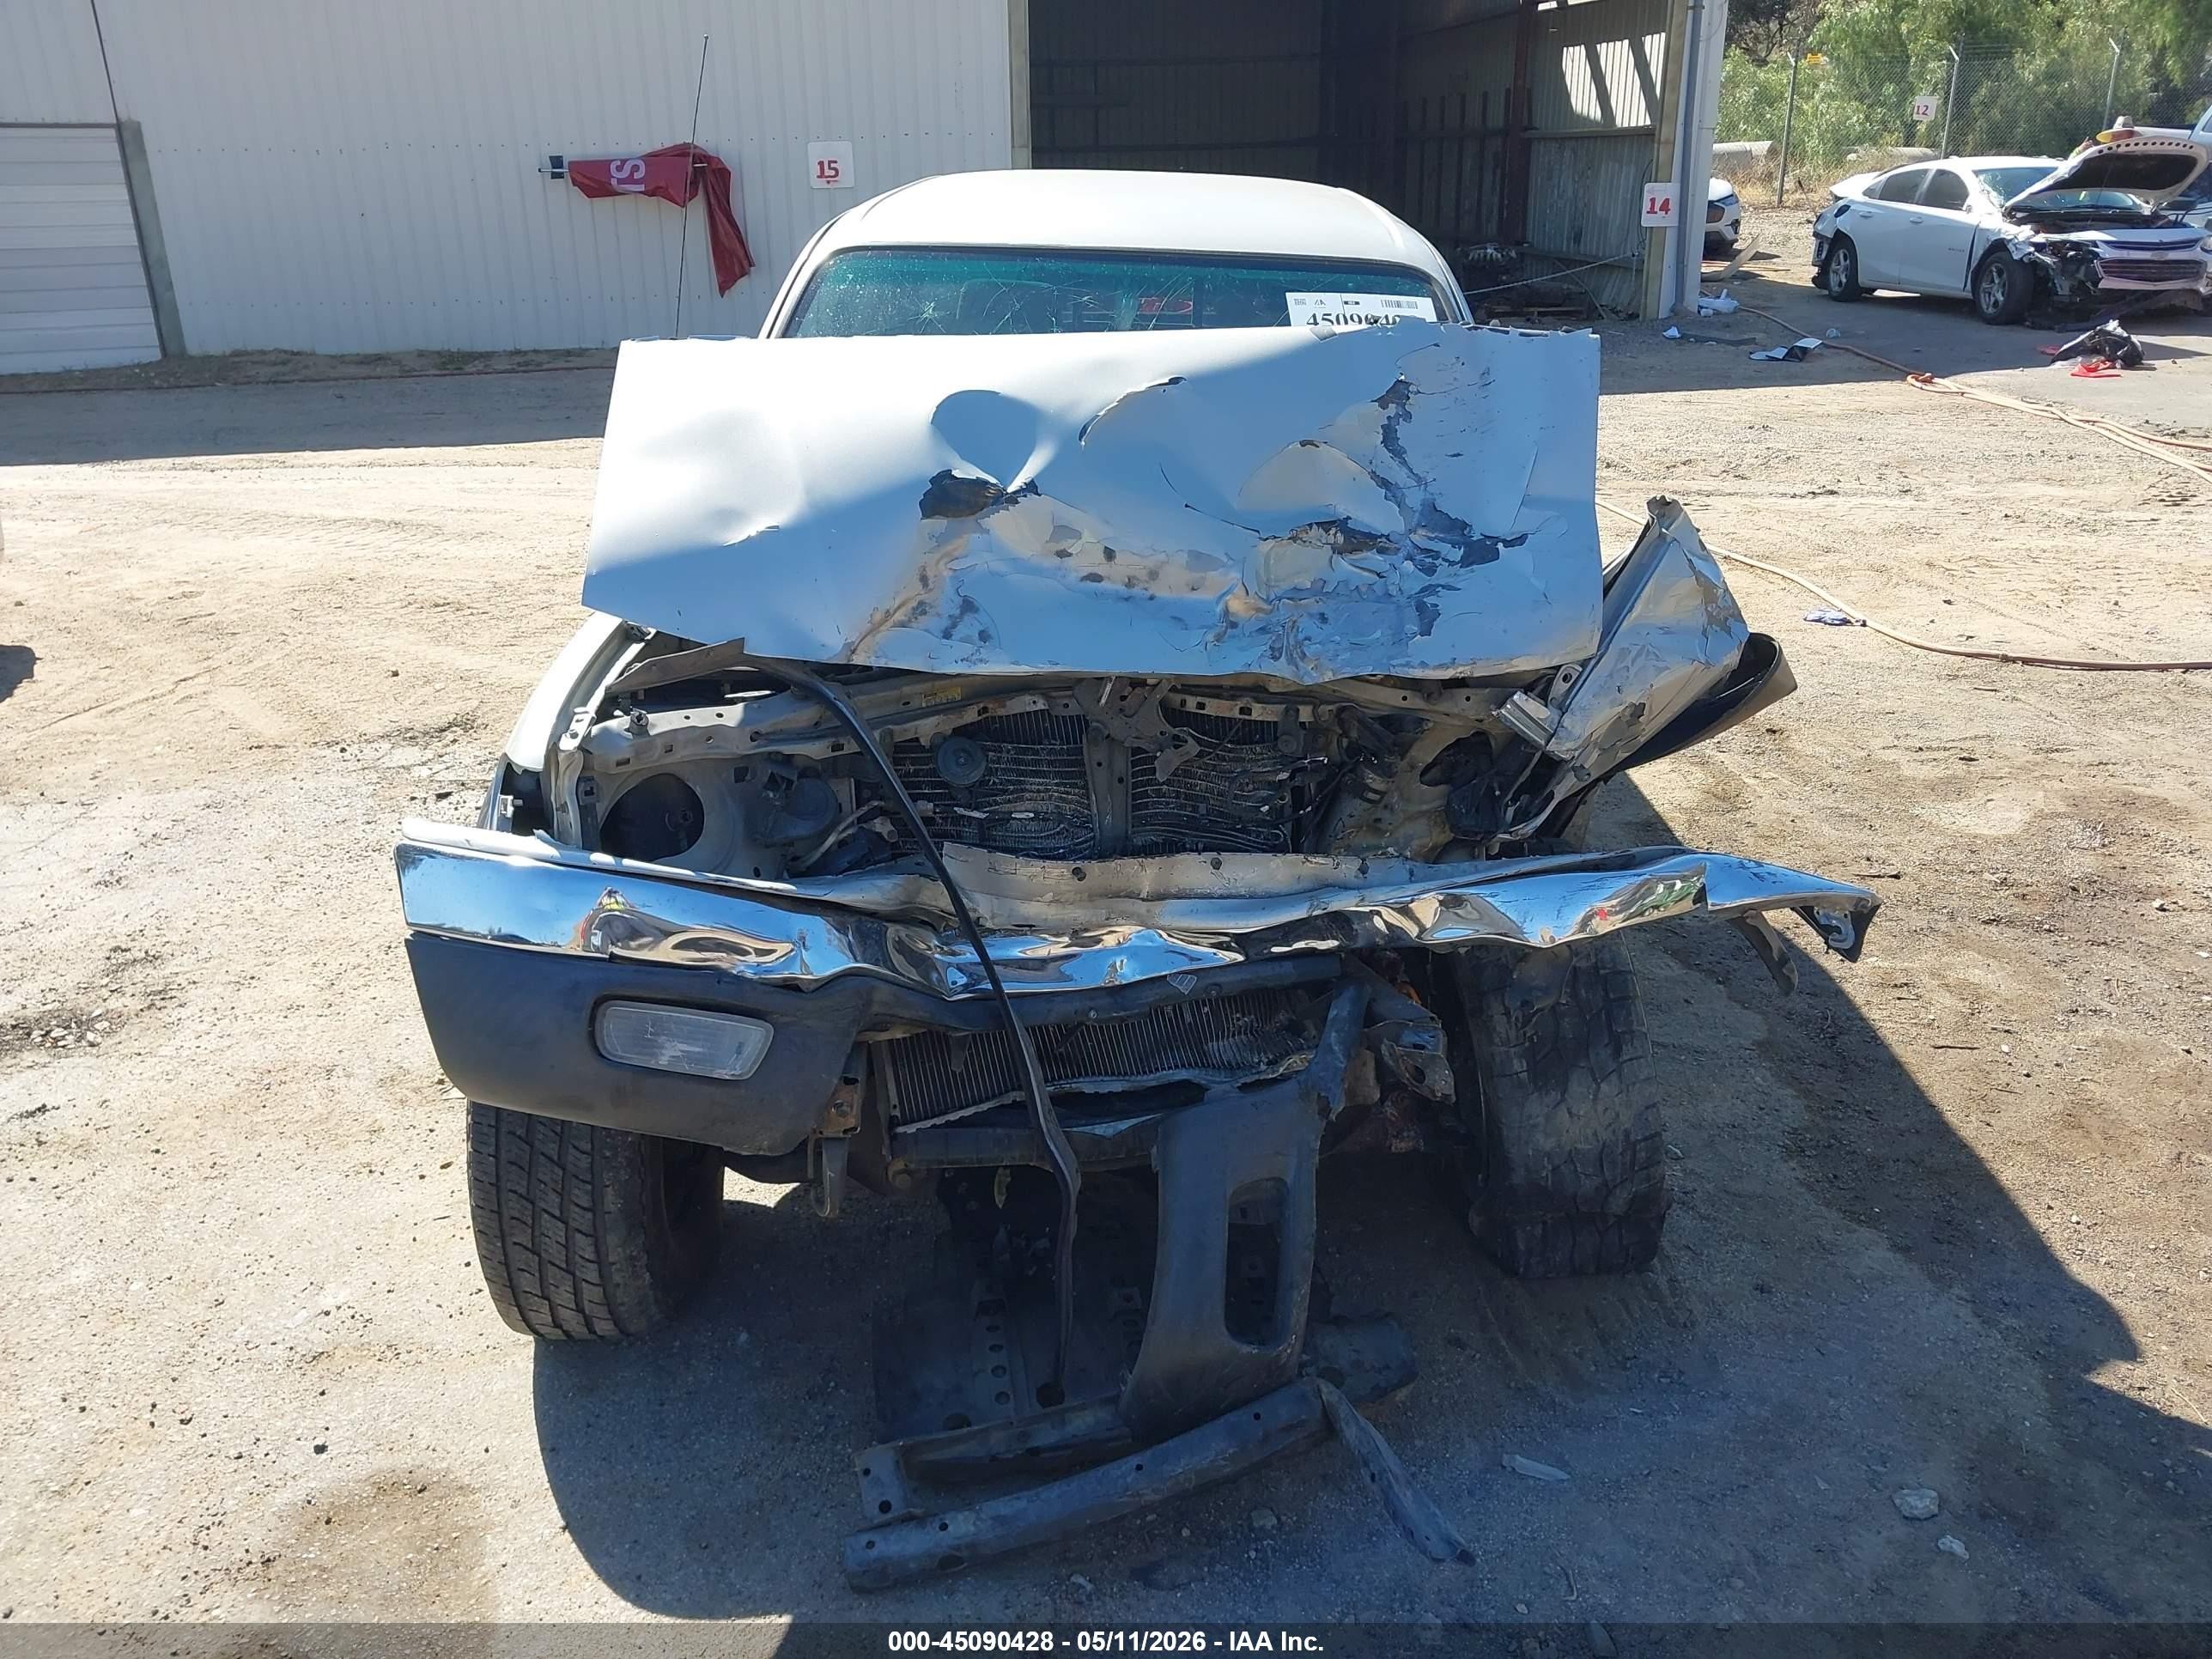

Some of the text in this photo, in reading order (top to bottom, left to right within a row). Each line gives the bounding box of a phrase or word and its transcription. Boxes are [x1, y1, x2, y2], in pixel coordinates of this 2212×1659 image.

[1916, 104, 1929, 116] 12
[816, 160, 840, 179] 15
[1646, 197, 1671, 215] 14
